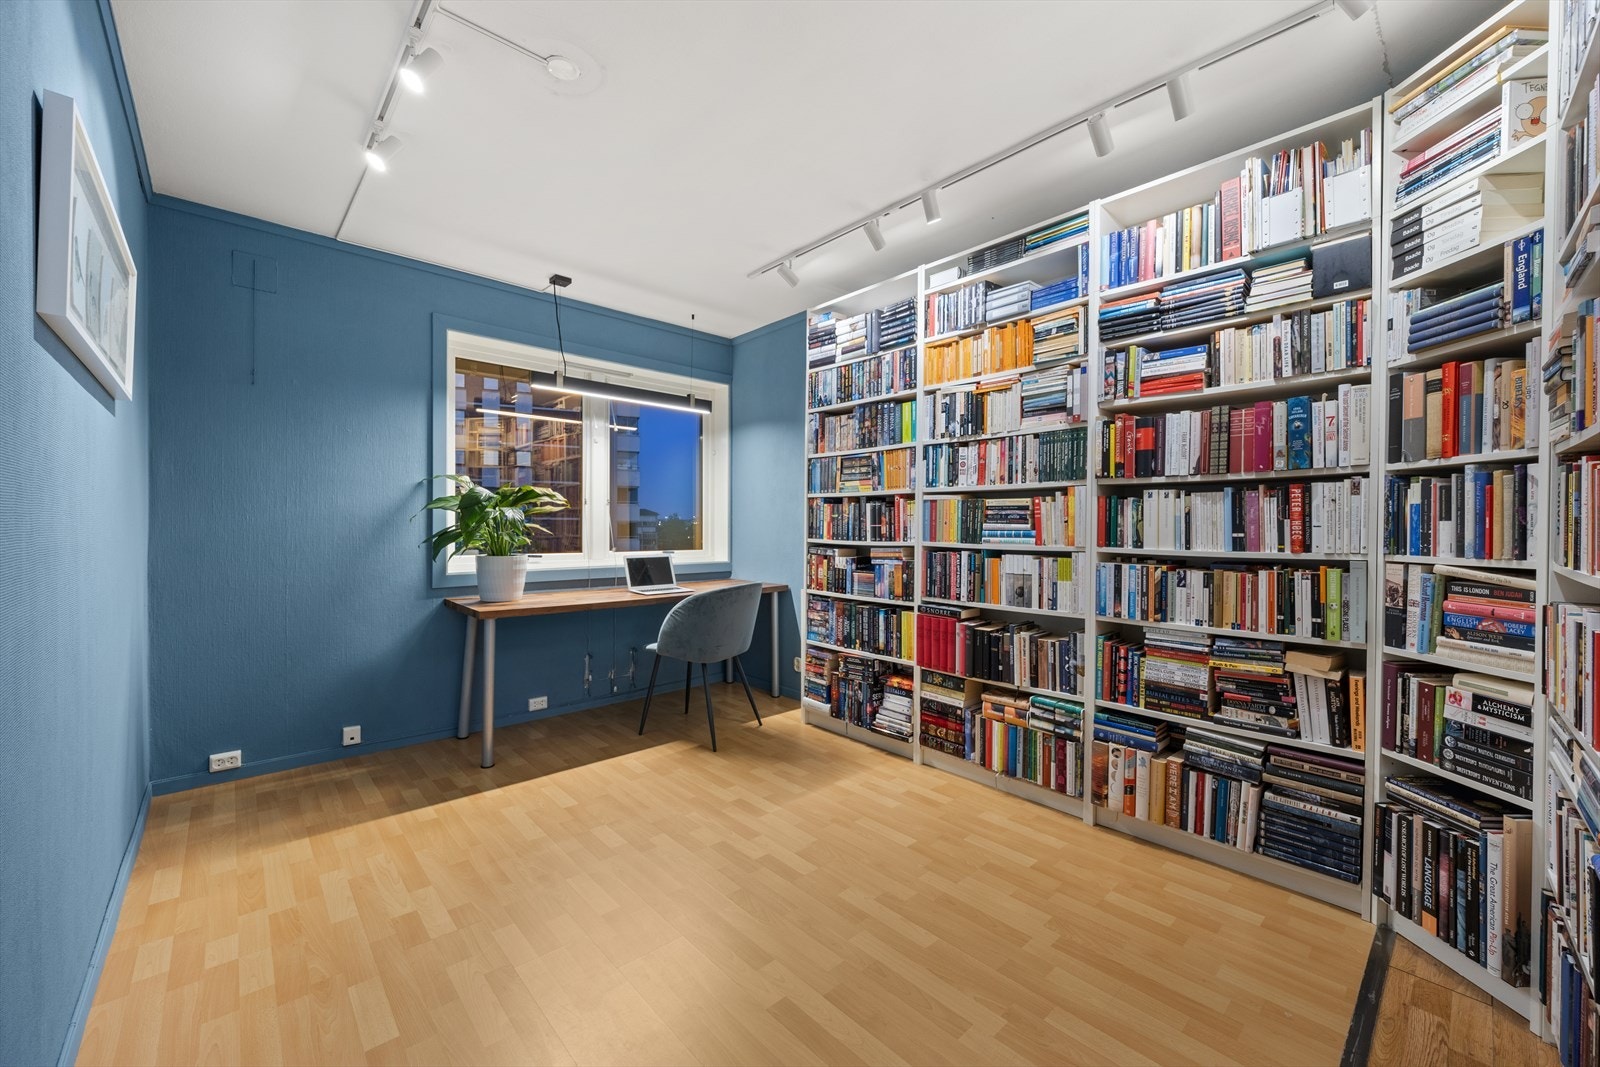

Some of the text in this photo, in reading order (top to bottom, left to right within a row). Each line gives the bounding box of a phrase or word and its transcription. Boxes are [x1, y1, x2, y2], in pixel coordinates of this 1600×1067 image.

[1222, 187, 1239, 246] RACHEL RISING
[1403, 212, 1420, 224] Baade
[1402, 225, 1420, 236] Baade
[1404, 237, 1421, 249] Baade
[1403, 262, 1420, 273] Baade
[1440, 245, 1460, 257] Fredag
[1405, 250, 1422, 262] Baade
[1516, 254, 1527, 289] England
[1502, 401, 1509, 410] 20
[1291, 489, 1301, 540] PETER HØEG
[926, 607, 951, 616] SNORRE
[1447, 616, 1479, 626] ENGLISH
[1504, 622, 1527, 630] ROBERT
[1171, 694, 1190, 703] RITES
[1482, 700, 1520, 713] ALCHEMY
[1482, 706, 1525, 722] MYSTICISM
[1168, 763, 1178, 810] HERE I AM
[1482, 775, 1516, 791] INVENTIONS
[1424, 857, 1432, 909] LANGUAGE
[1488, 862, 1498, 956] The Great American Pin-Up
